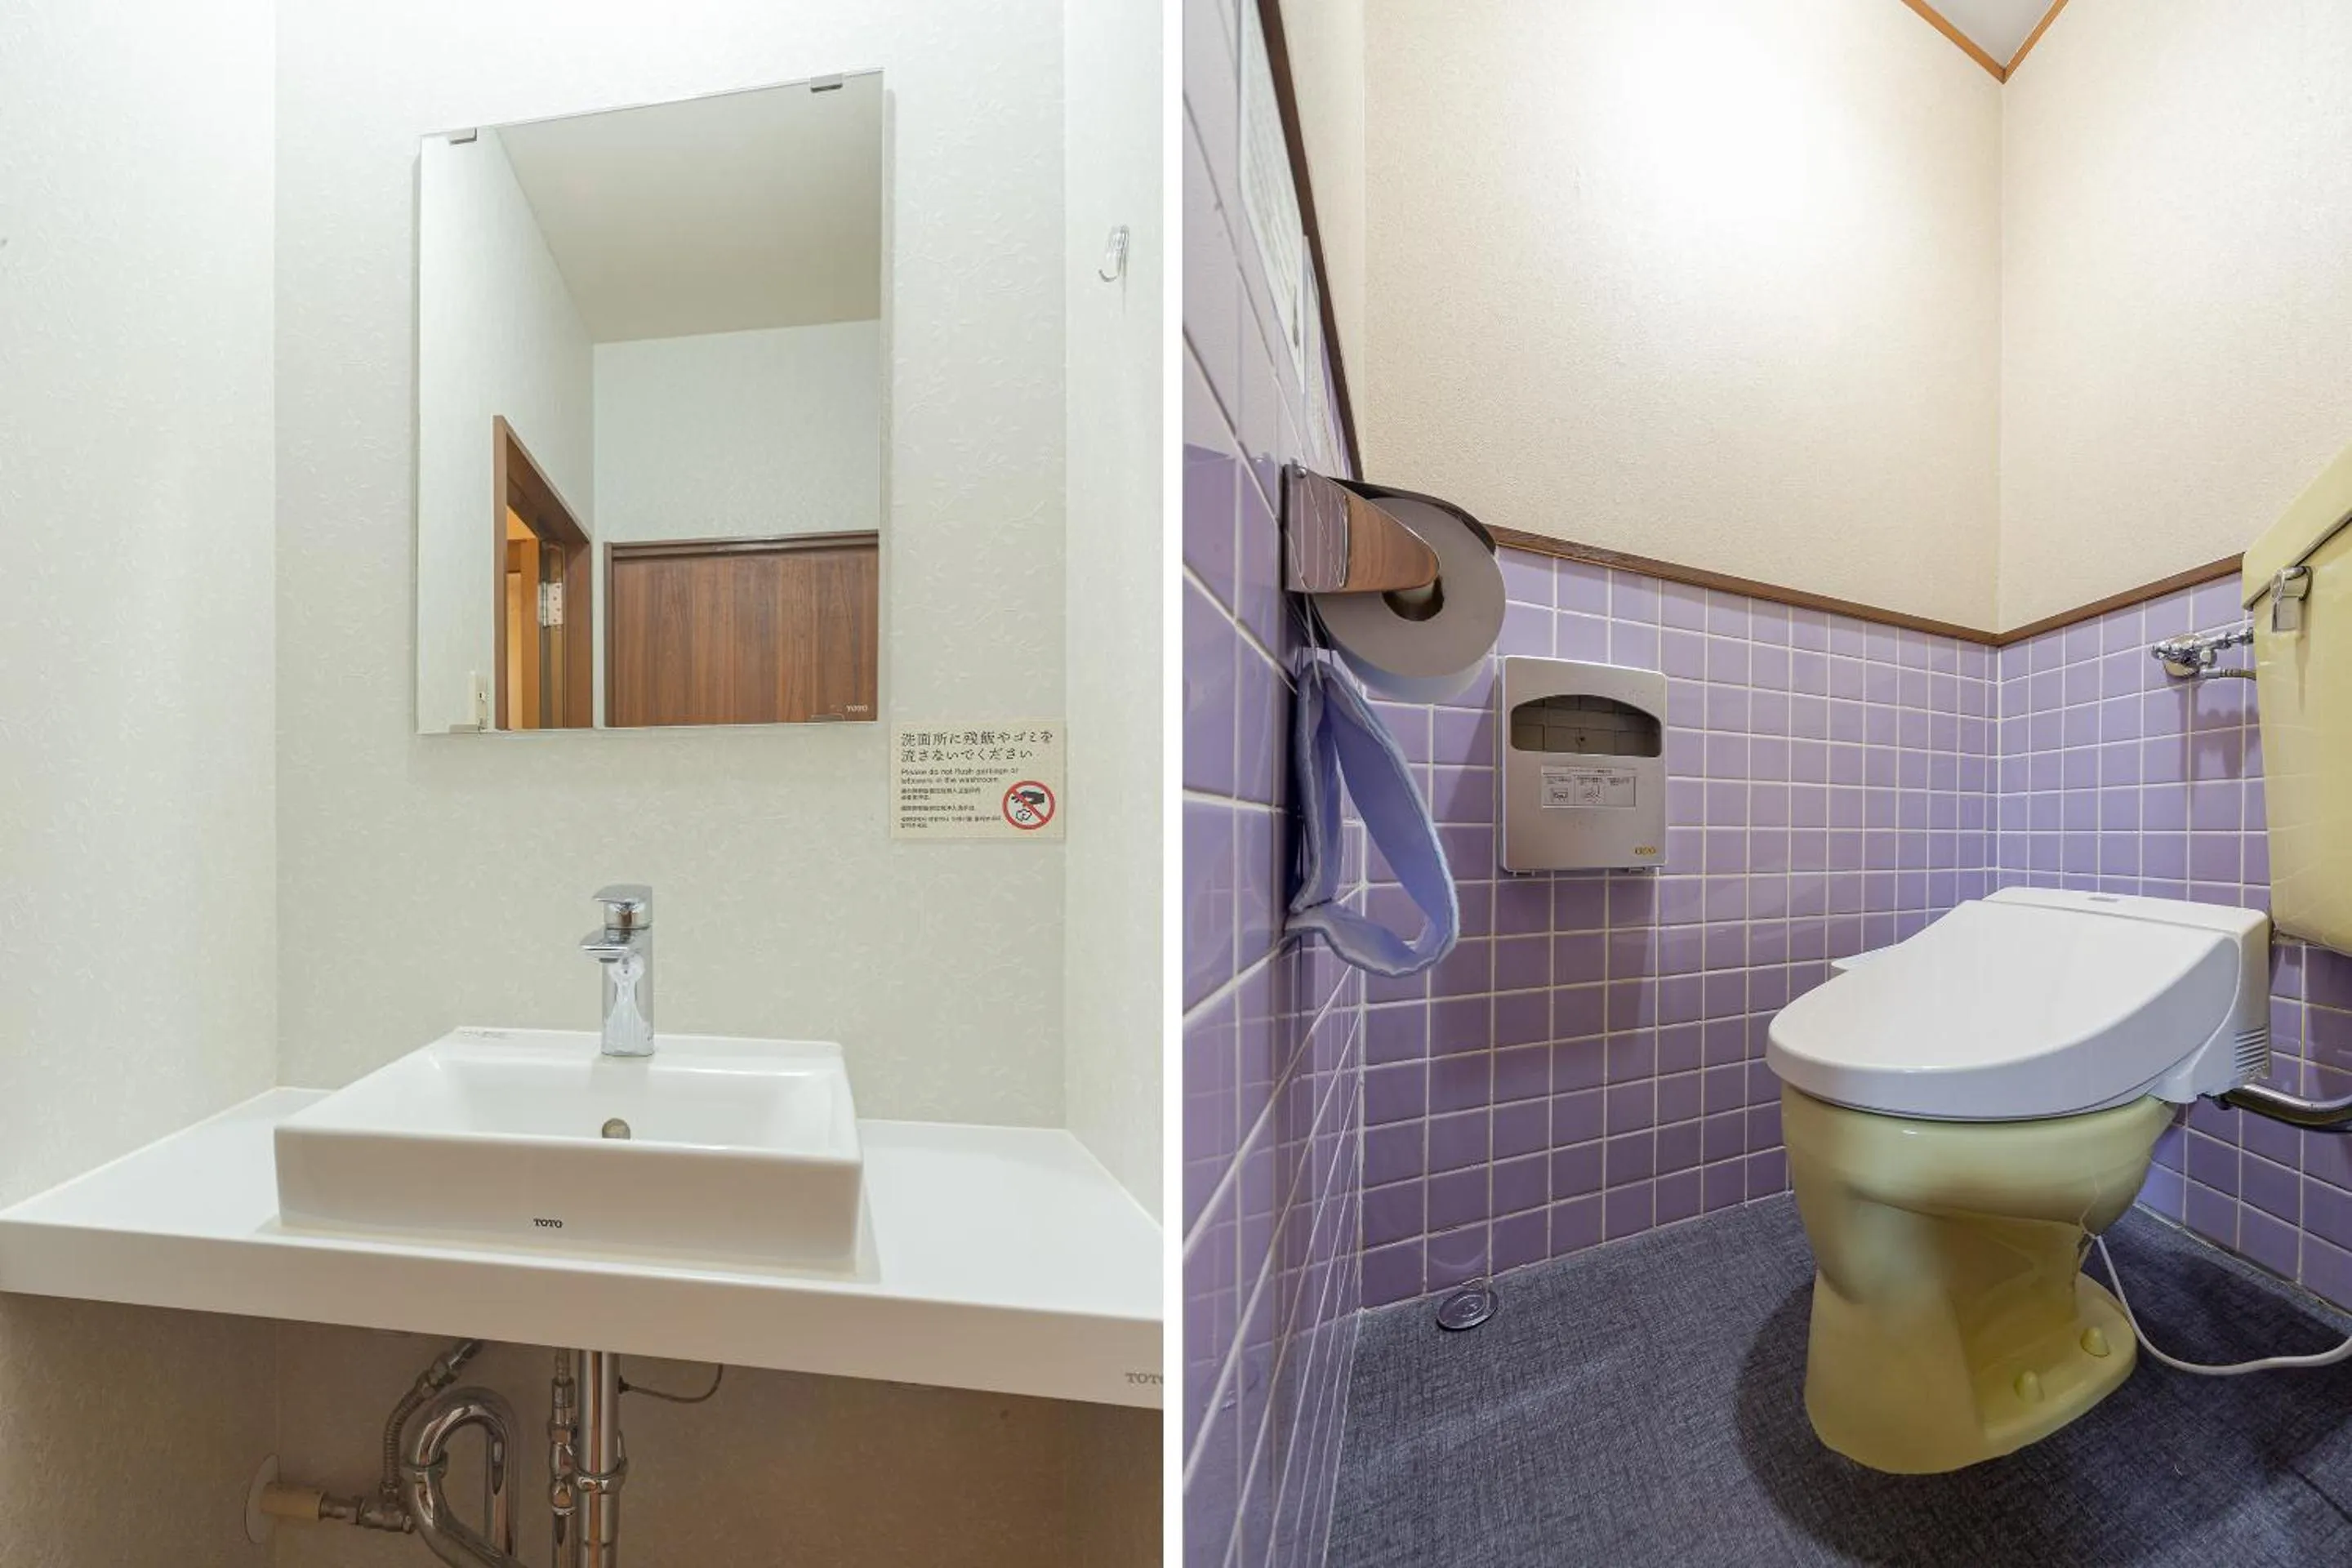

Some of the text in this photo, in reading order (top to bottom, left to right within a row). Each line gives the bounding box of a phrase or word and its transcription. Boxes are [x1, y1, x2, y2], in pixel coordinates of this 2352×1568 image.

[901, 730, 1054, 746] 洗面所に残飯やゴミを
[901, 747, 1034, 763] 流さないでください
[532, 1218, 564, 1229] TOTO
